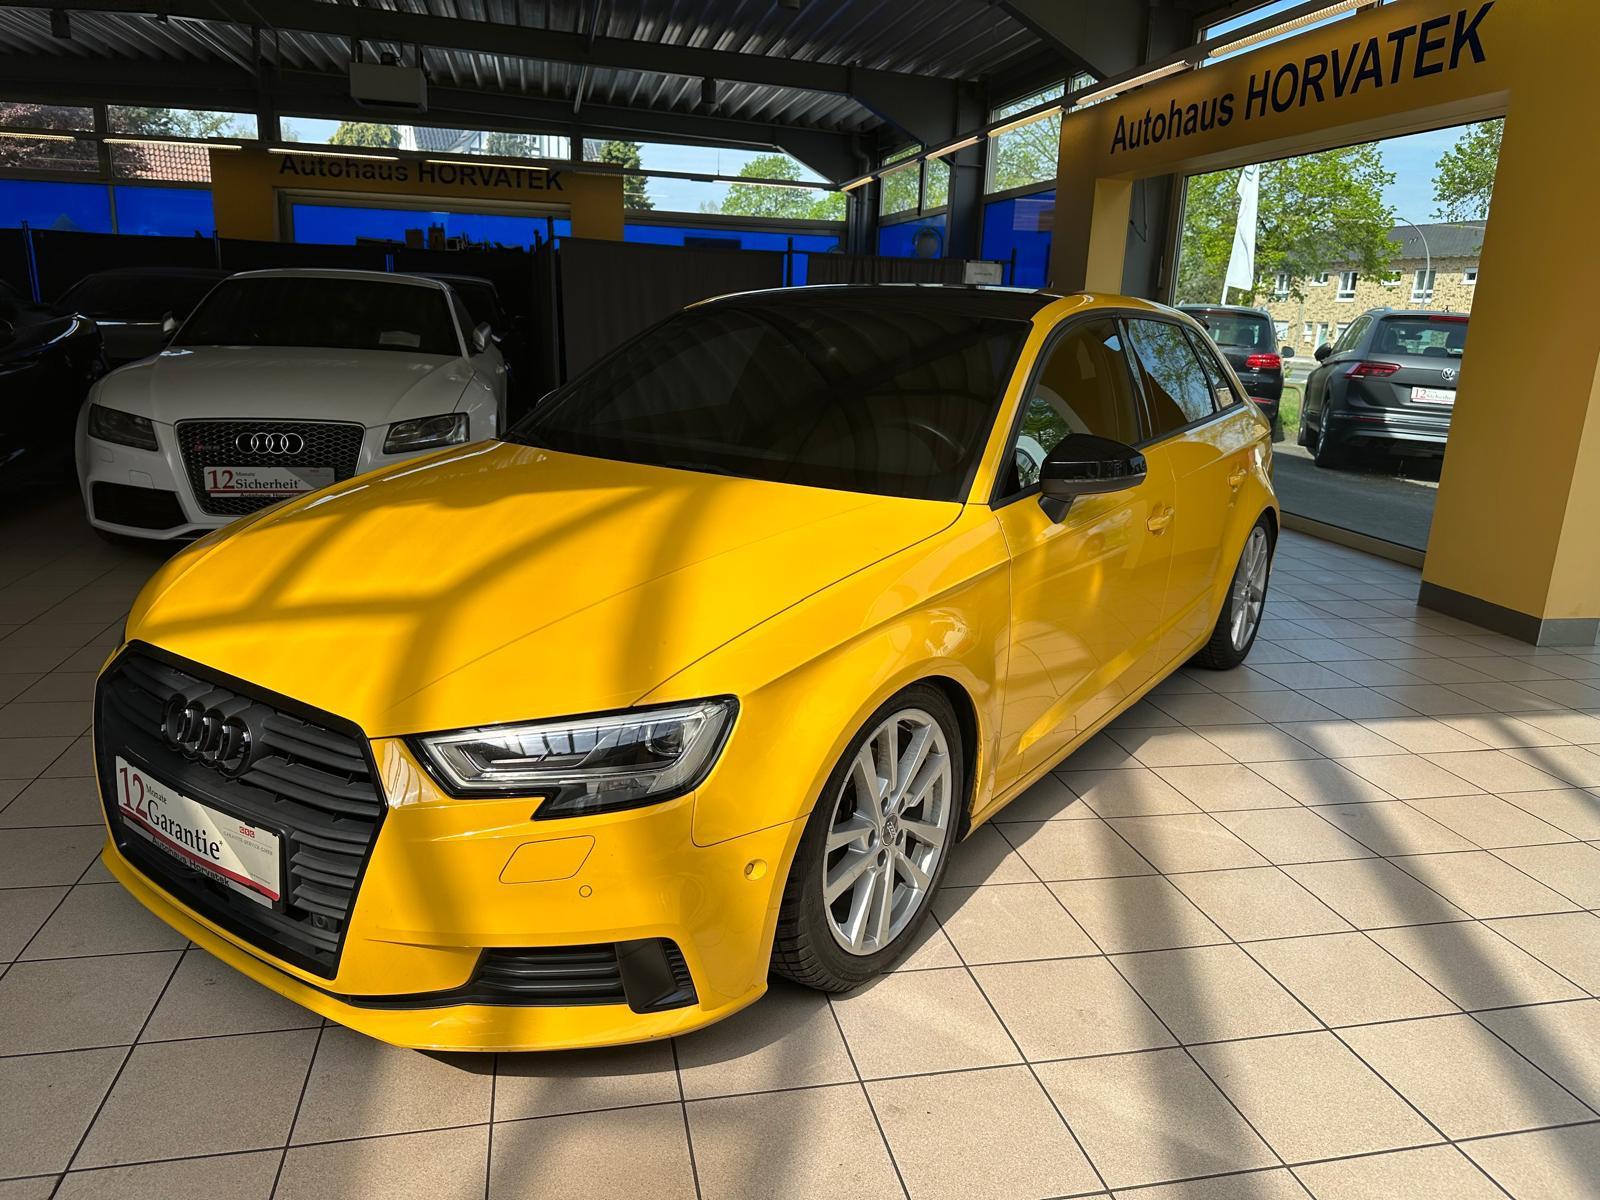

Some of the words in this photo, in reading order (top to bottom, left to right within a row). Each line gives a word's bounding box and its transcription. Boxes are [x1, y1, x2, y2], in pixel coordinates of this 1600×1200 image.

[1110, 92, 1235, 154] Autohaus
[1244, 2, 1494, 121] HORVATEK
[279, 153, 408, 182] Autohaus
[418, 160, 564, 192] HORVATEK
[208, 469, 235, 490] 12
[119, 766, 148, 820] 12
[145, 783, 168, 805] Monate
[189, 858, 231, 887] Horvatek
